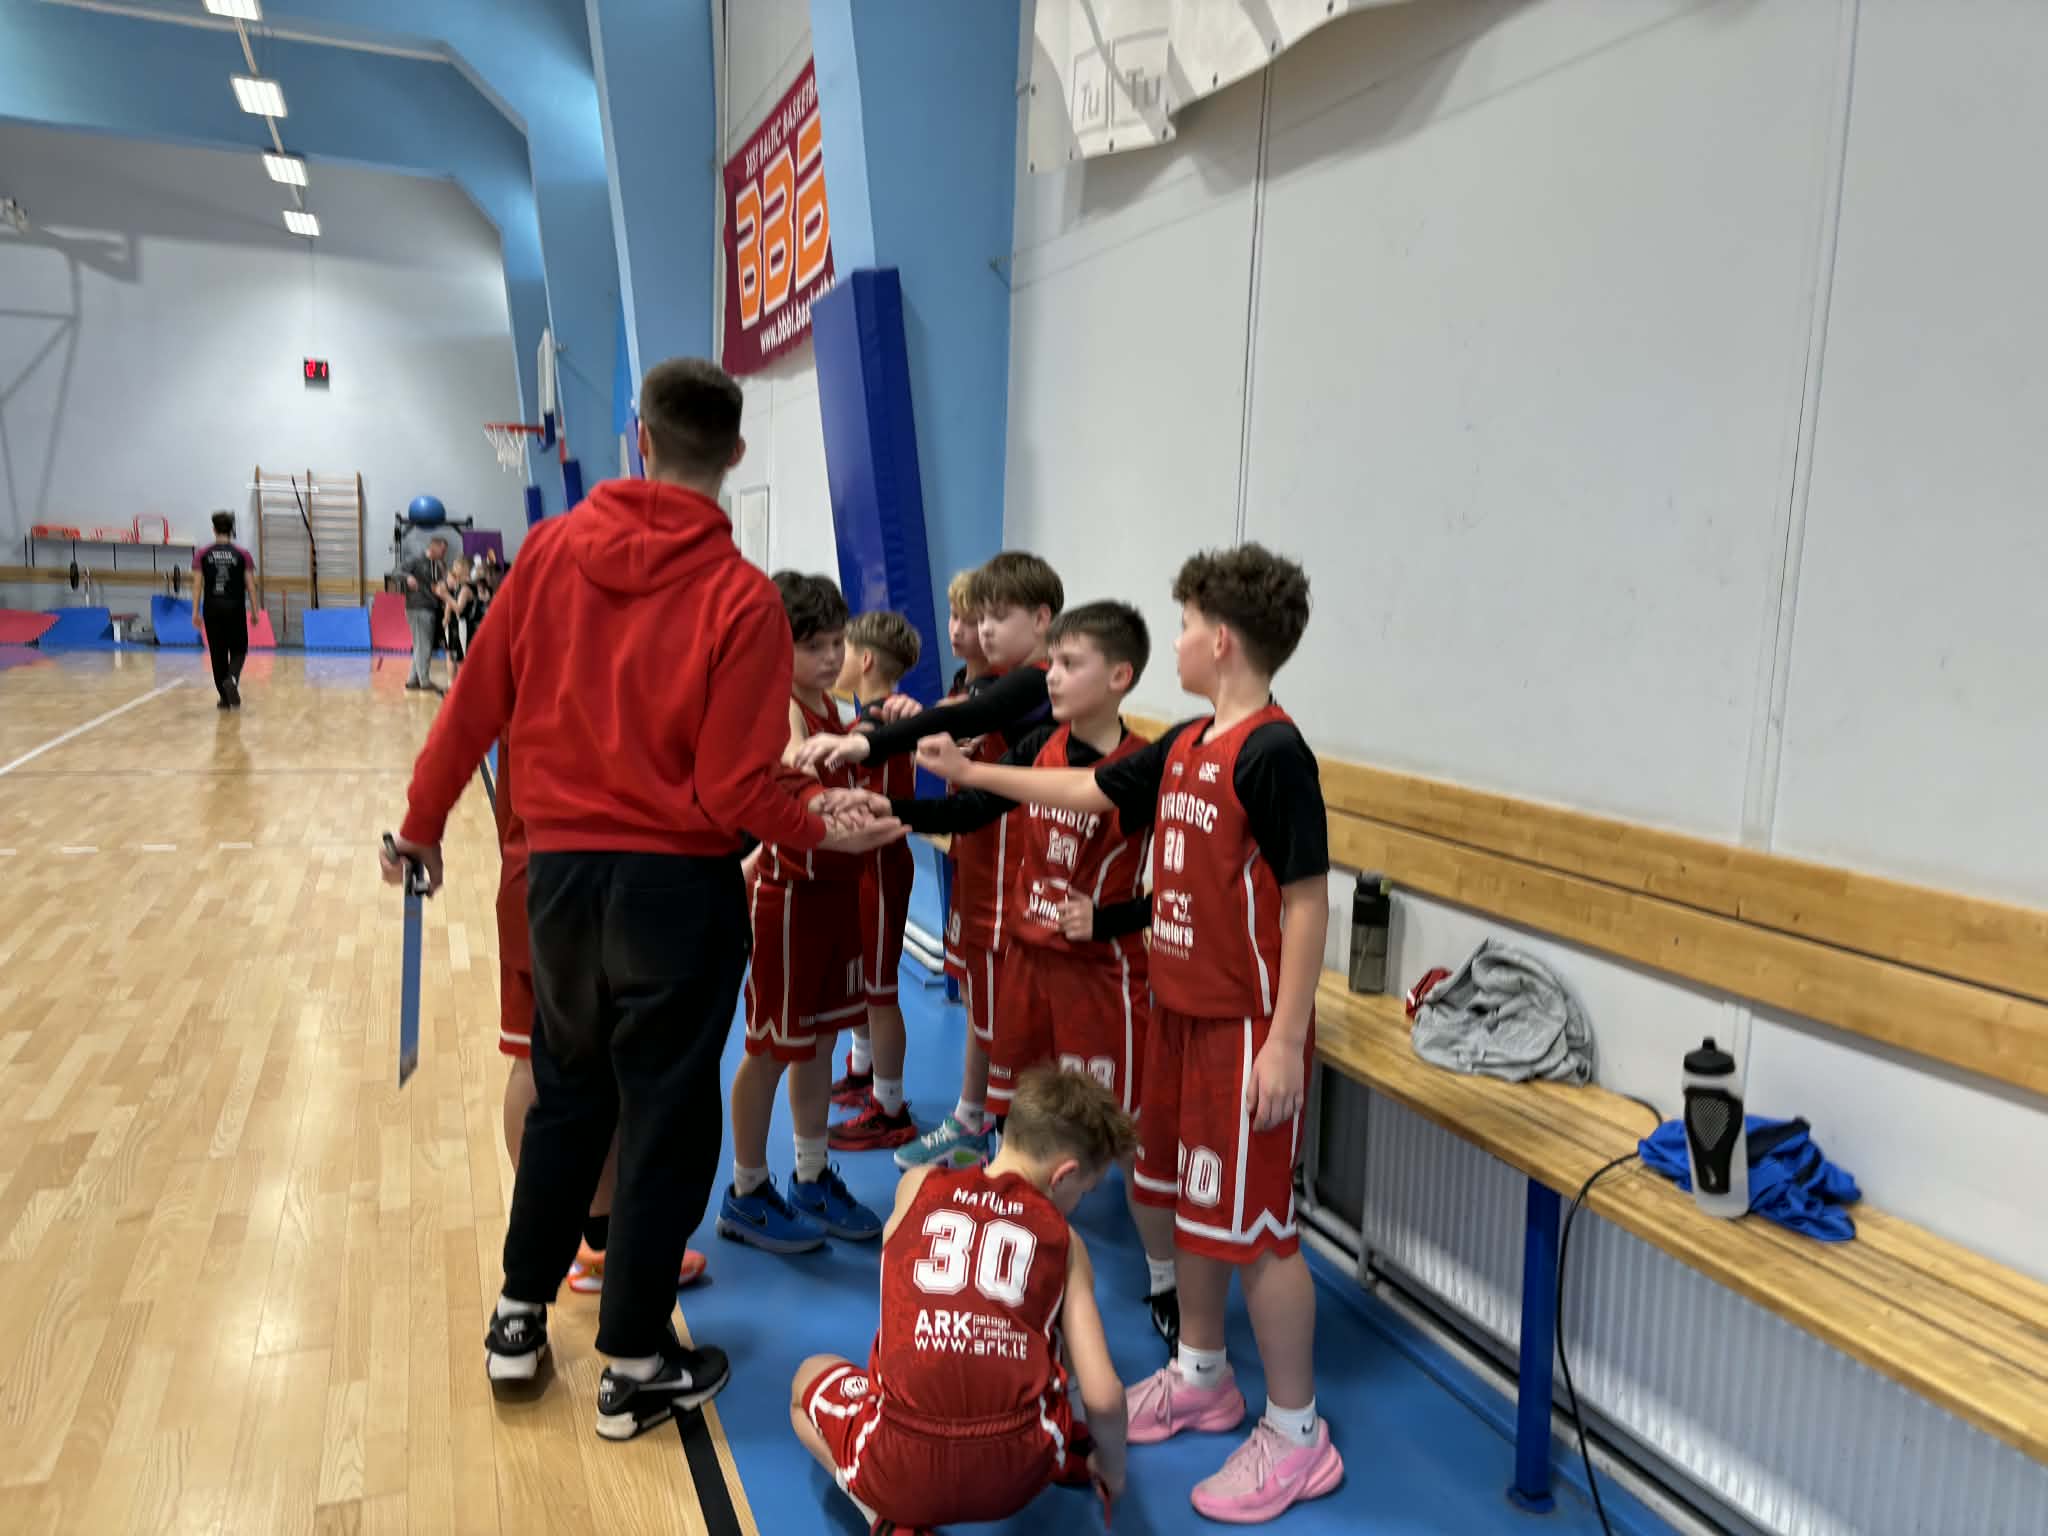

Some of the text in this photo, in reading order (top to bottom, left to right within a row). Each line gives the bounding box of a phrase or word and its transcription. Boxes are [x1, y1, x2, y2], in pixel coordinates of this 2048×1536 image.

[1177, 1136, 1222, 1209] 0
[912, 1208, 1038, 1308] 30
[915, 1309, 974, 1339] ARK
[915, 1336, 1028, 1360] www.ark.lt
